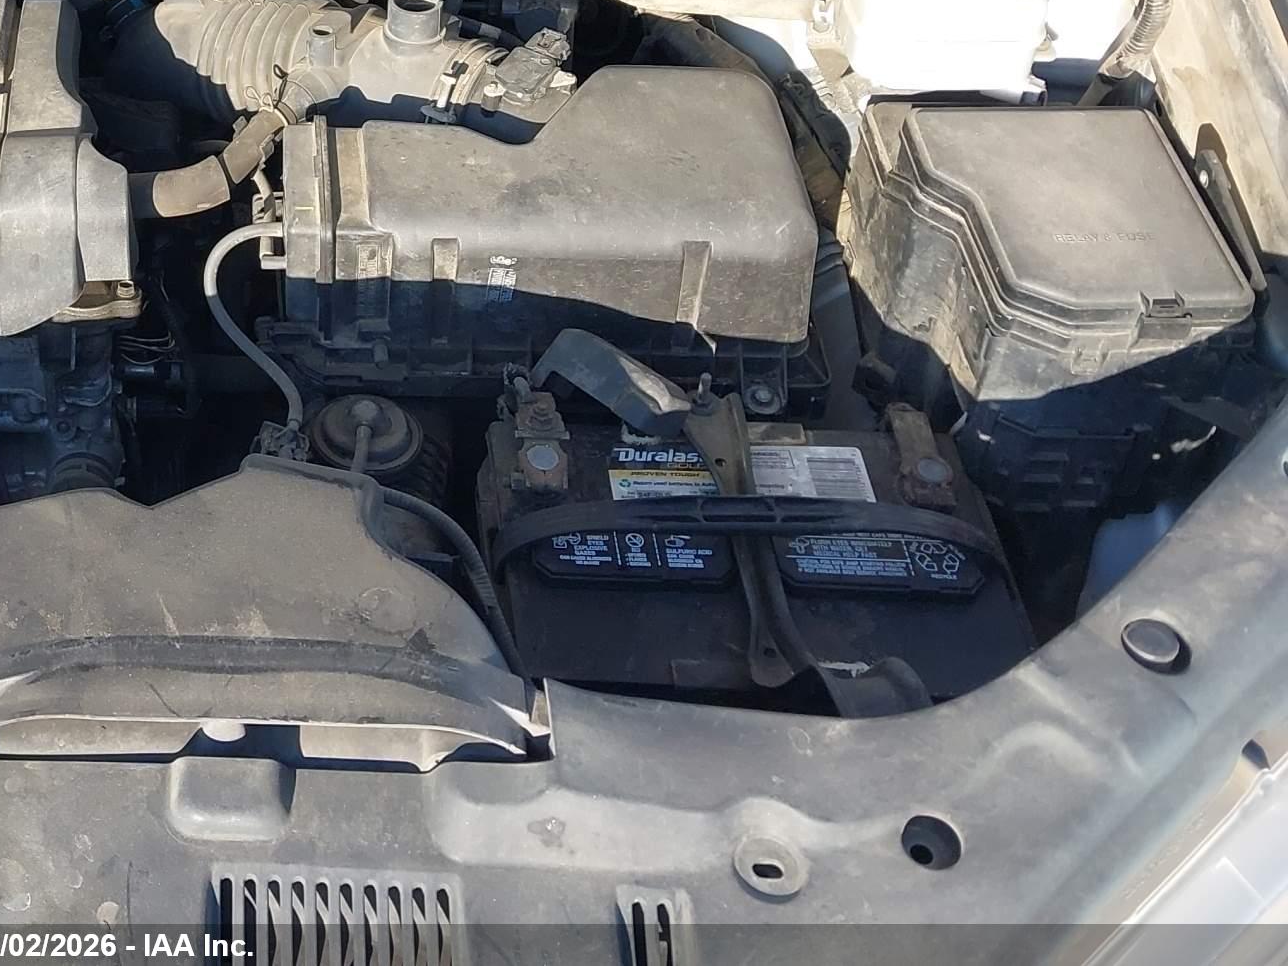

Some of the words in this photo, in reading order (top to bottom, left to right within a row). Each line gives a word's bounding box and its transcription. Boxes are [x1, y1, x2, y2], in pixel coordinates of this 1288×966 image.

[1054, 233, 1098, 242] RELAY
[1103, 233, 1112, 242] &
[613, 448, 705, 462] Duralas
